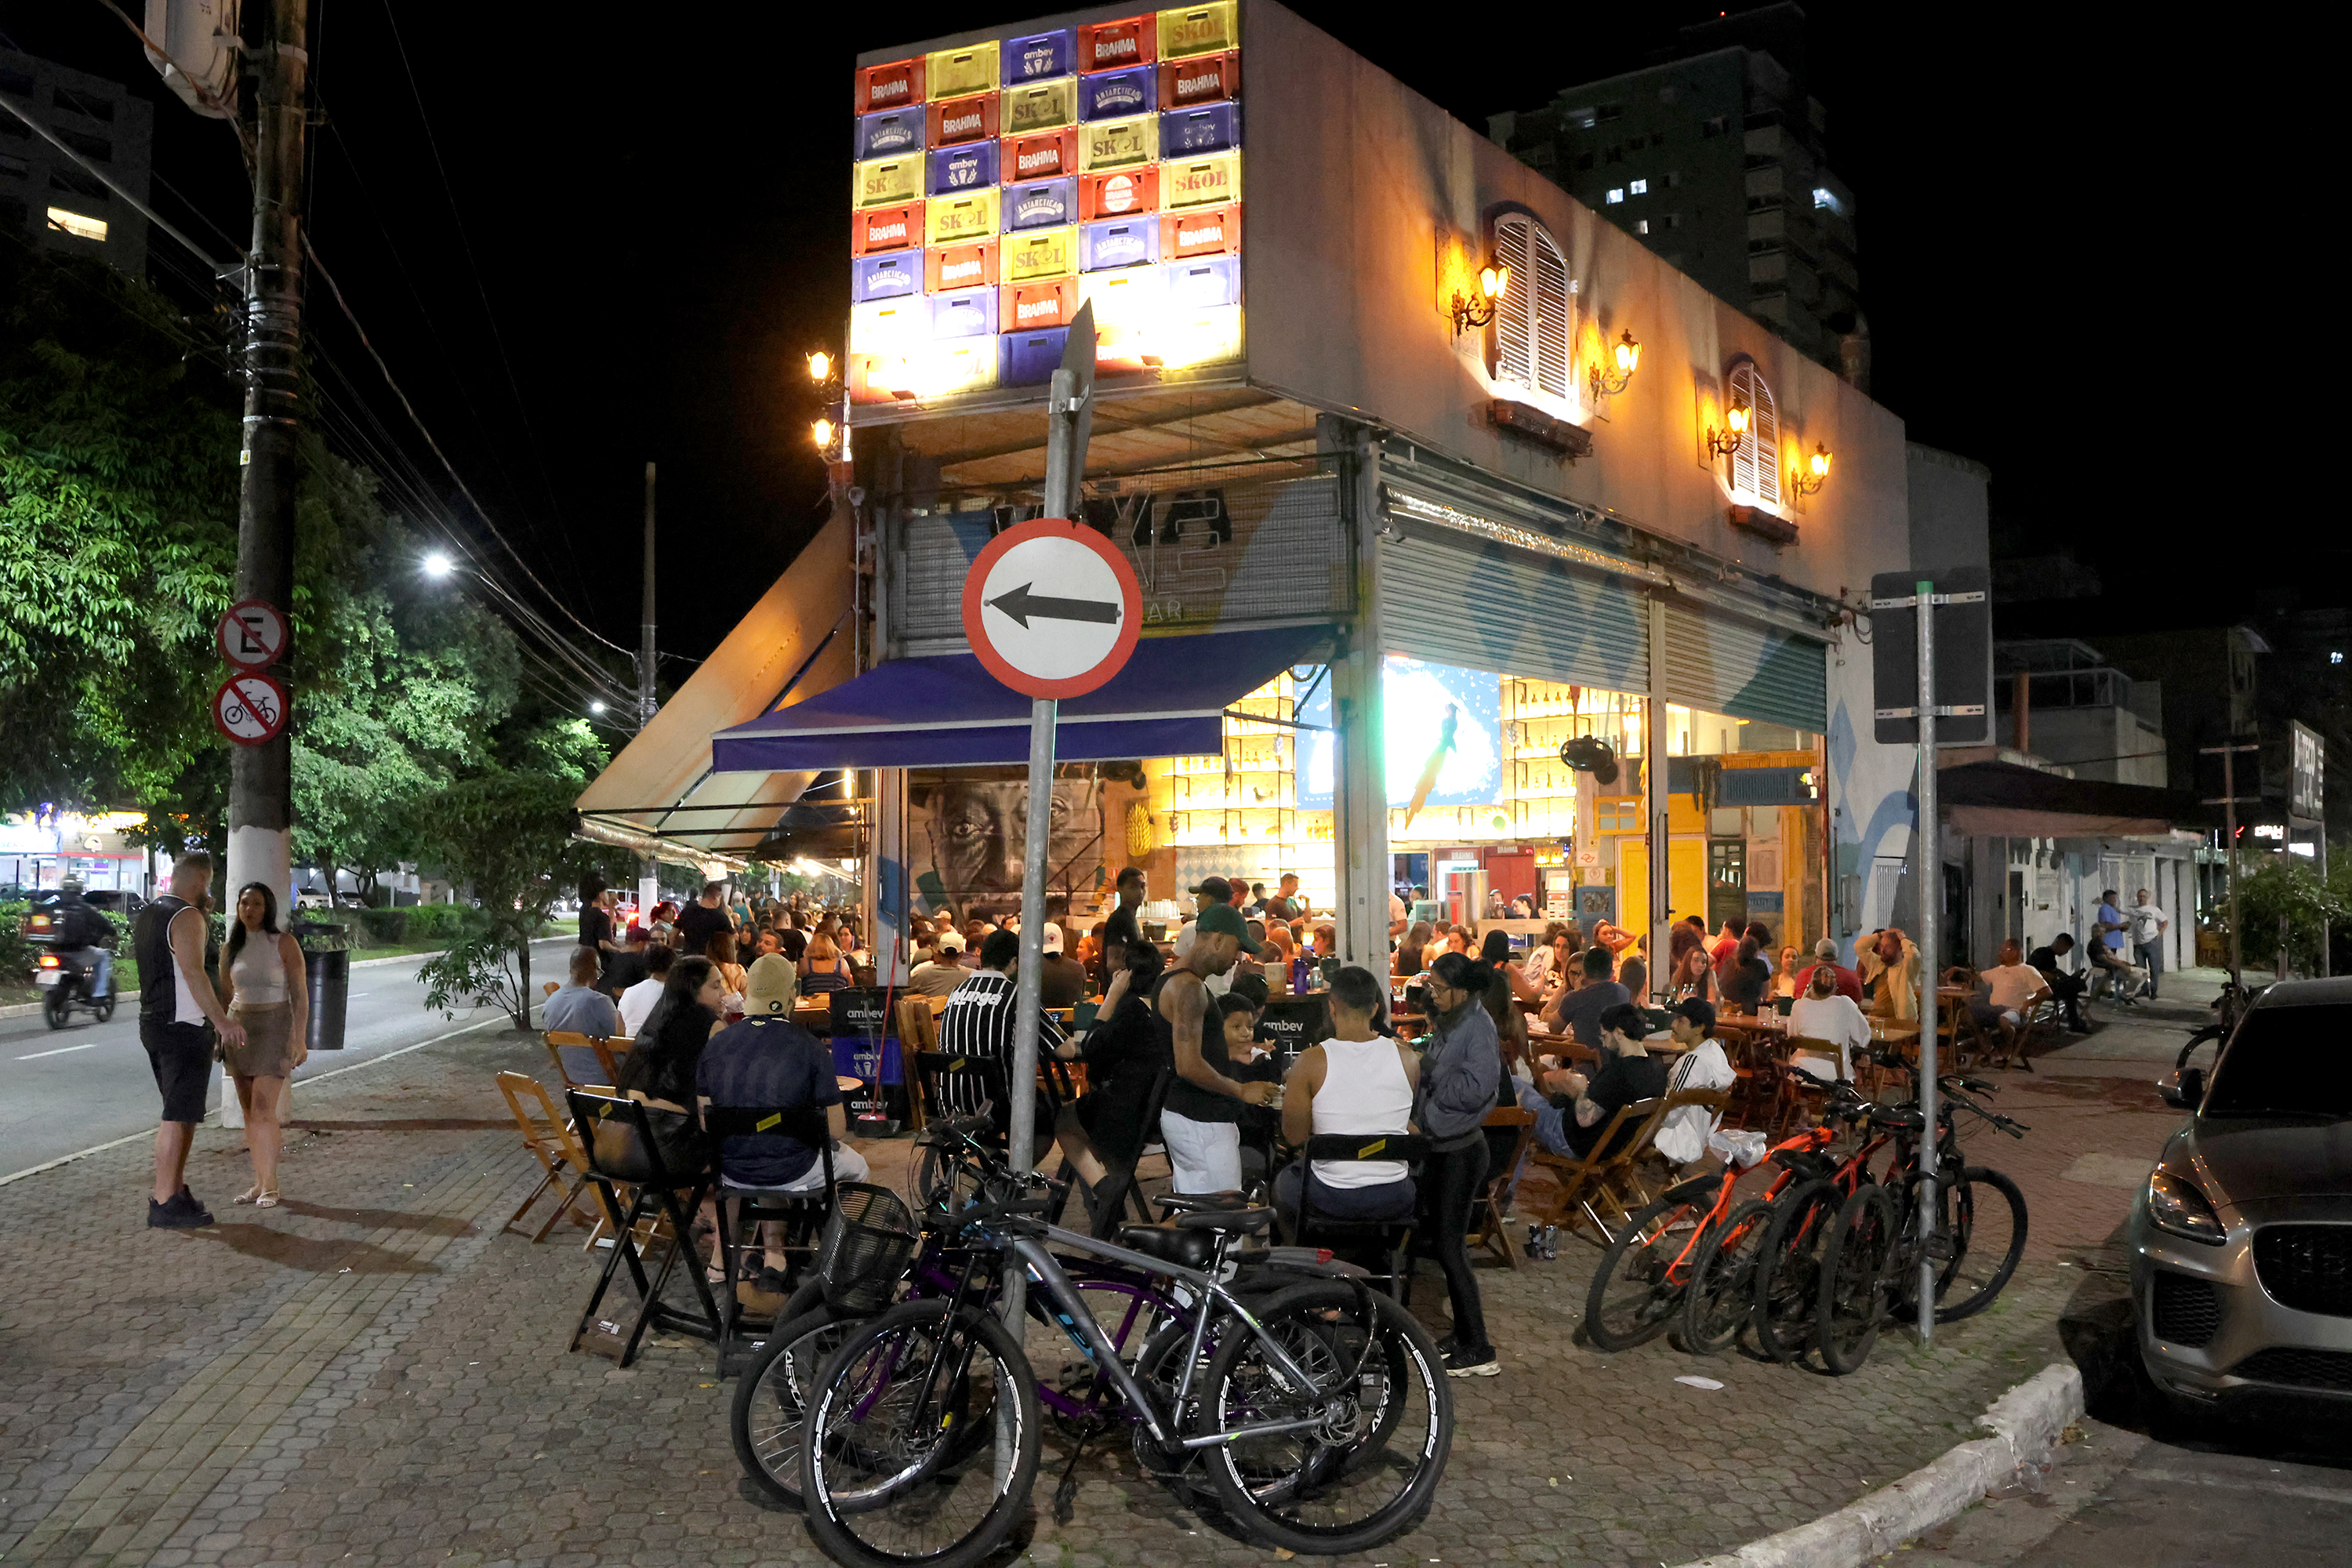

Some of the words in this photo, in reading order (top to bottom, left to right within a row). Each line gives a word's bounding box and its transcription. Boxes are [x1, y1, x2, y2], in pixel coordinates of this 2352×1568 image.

[1024, 48, 1054, 60] ambev
[1095, 38, 1136, 58] BRAHMA
[871, 79, 908, 100] BRAHMA
[1178, 74, 1219, 94] BRAHMA
[1095, 86, 1136, 103] ANTARCTICA
[1014, 100, 1062, 121] SKOL
[943, 114, 982, 133] BRAHMA
[1093, 136, 1142, 158] SKOL
[949, 159, 978, 171] ambev
[1019, 149, 1058, 169] BRAHMA
[1176, 171, 1227, 192] SKOL
[1105, 189, 1132, 200] BRAHMA
[1018, 198, 1058, 214] ANTARCTICA
[940, 210, 986, 231] SKOL
[869, 223, 907, 241] BRAHMA
[1179, 227, 1223, 247] BRAHMA
[1015, 248, 1064, 269] SKOL
[867, 270, 906, 285] ANTARCTICA
[942, 260, 982, 280] BRAHMA
[1018, 299, 1058, 319] BRAHMA
[1147, 600, 1181, 621] AR
[241, 616, 264, 653] E
[1451, 851, 1475, 860] BRAHMA
